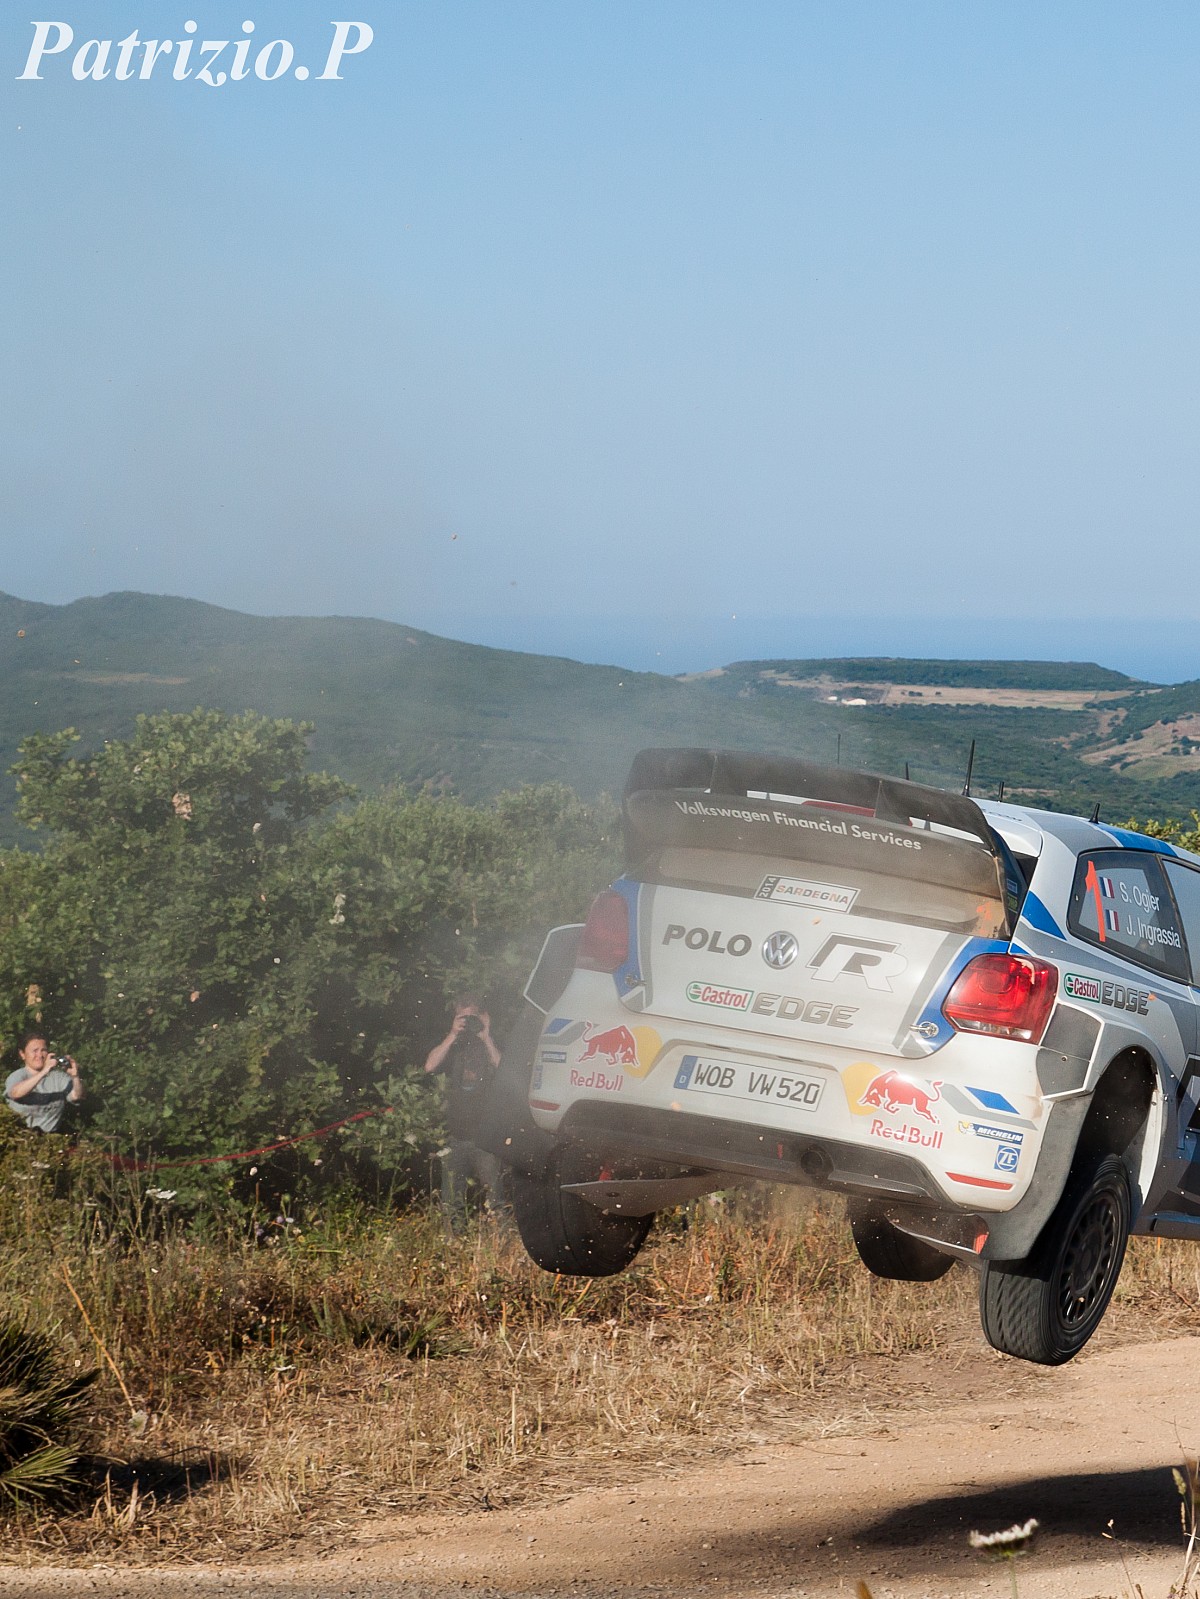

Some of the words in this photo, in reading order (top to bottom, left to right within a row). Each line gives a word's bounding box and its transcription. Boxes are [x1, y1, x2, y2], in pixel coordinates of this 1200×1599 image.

[675, 800, 771, 823] Volkswagen
[772, 811, 848, 836] Financial
[850, 825, 922, 850] Services
[759, 877, 776, 898] 2014
[776, 884, 849, 904] SARDEGNA
[1085, 860, 1106, 942] 1
[1119, 881, 1132, 904] S.
[1132, 885, 1160, 913] Ogier
[661, 924, 752, 957] POLO
[1126, 914, 1136, 936] J.
[1137, 917, 1181, 948] Ingrassia
[701, 985, 749, 1009] Castrol
[751, 992, 860, 1029] EDGE
[1073, 977, 1099, 999] Castrol
[1101, 980, 1149, 1016] EDGE
[570, 1069, 595, 1088] Red
[595, 1072, 624, 1091] Bull
[694, 1063, 736, 1088] WOB
[748, 1072, 777, 1096] VW
[776, 1077, 820, 1105] 520
[870, 1119, 907, 1142] Red
[907, 1127, 944, 1149] Bull
[977, 1126, 1023, 1143] MICHELIN
